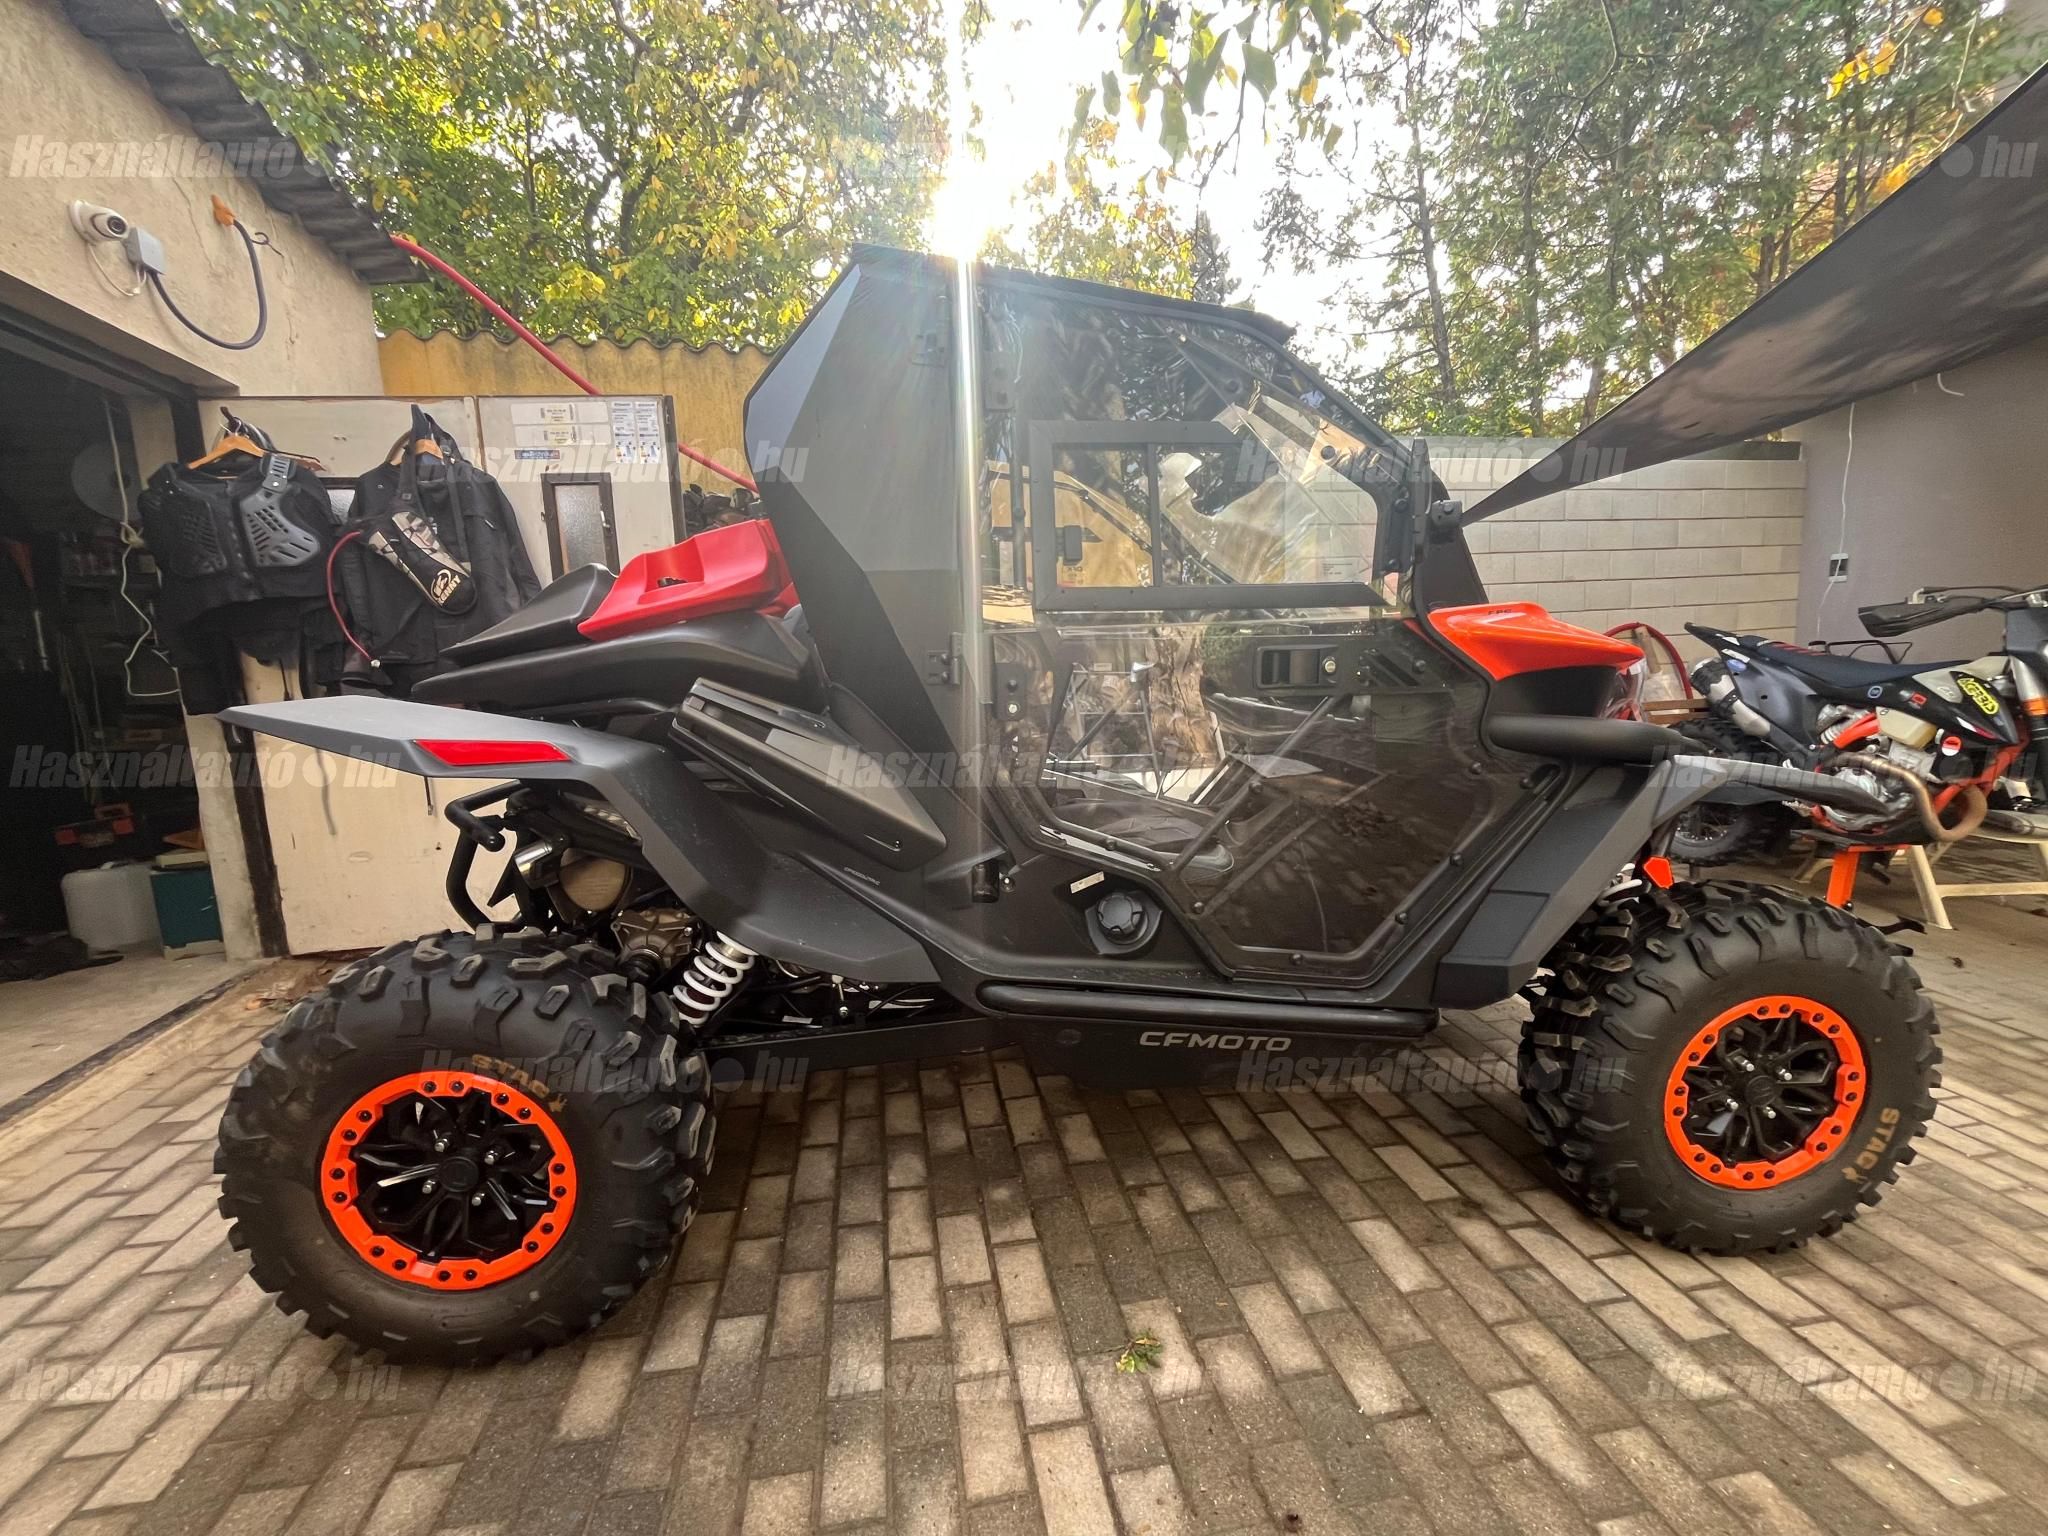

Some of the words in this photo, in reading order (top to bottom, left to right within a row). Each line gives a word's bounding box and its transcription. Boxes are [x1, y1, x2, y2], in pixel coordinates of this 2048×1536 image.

[1139, 1031, 1292, 1051] CFMOTO
[471, 1054, 551, 1099] STAG
[1856, 1107, 1900, 1170] STAG
